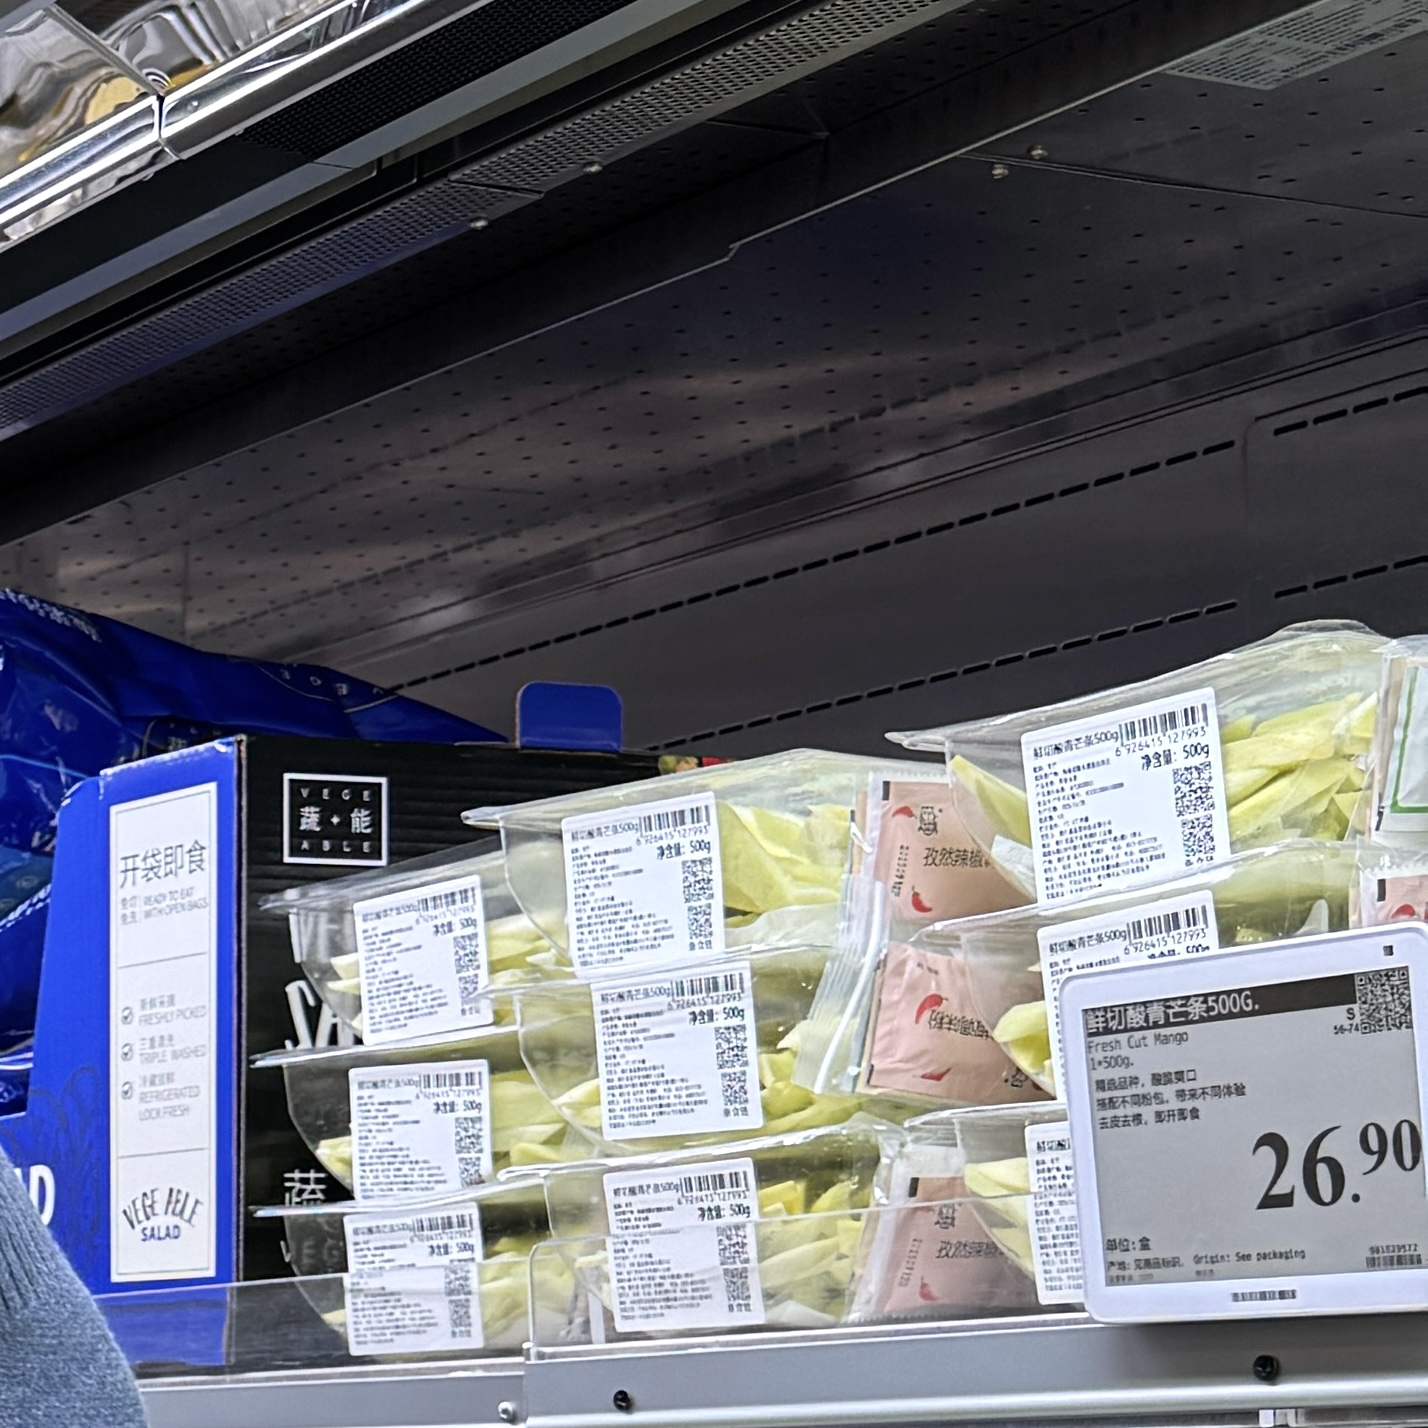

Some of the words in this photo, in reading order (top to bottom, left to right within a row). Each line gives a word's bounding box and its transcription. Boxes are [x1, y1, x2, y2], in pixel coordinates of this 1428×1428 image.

[1141, 749, 1177, 771] 净含量:
[1182, 743, 1210, 759] 500g
[690, 840, 711, 854] 500g
[119, 839, 206, 889] 开袋即食
[723, 1006, 745, 1021] 500g
[1088, 1039, 1122, 1055] Fresh
[1127, 1034, 1149, 1049] Cut
[1154, 1030, 1189, 1047] Mango
[462, 1100, 482, 1115] 500g
[729, 1203, 751, 1218] 500g
[141, 1224, 181, 1242] SALAD
